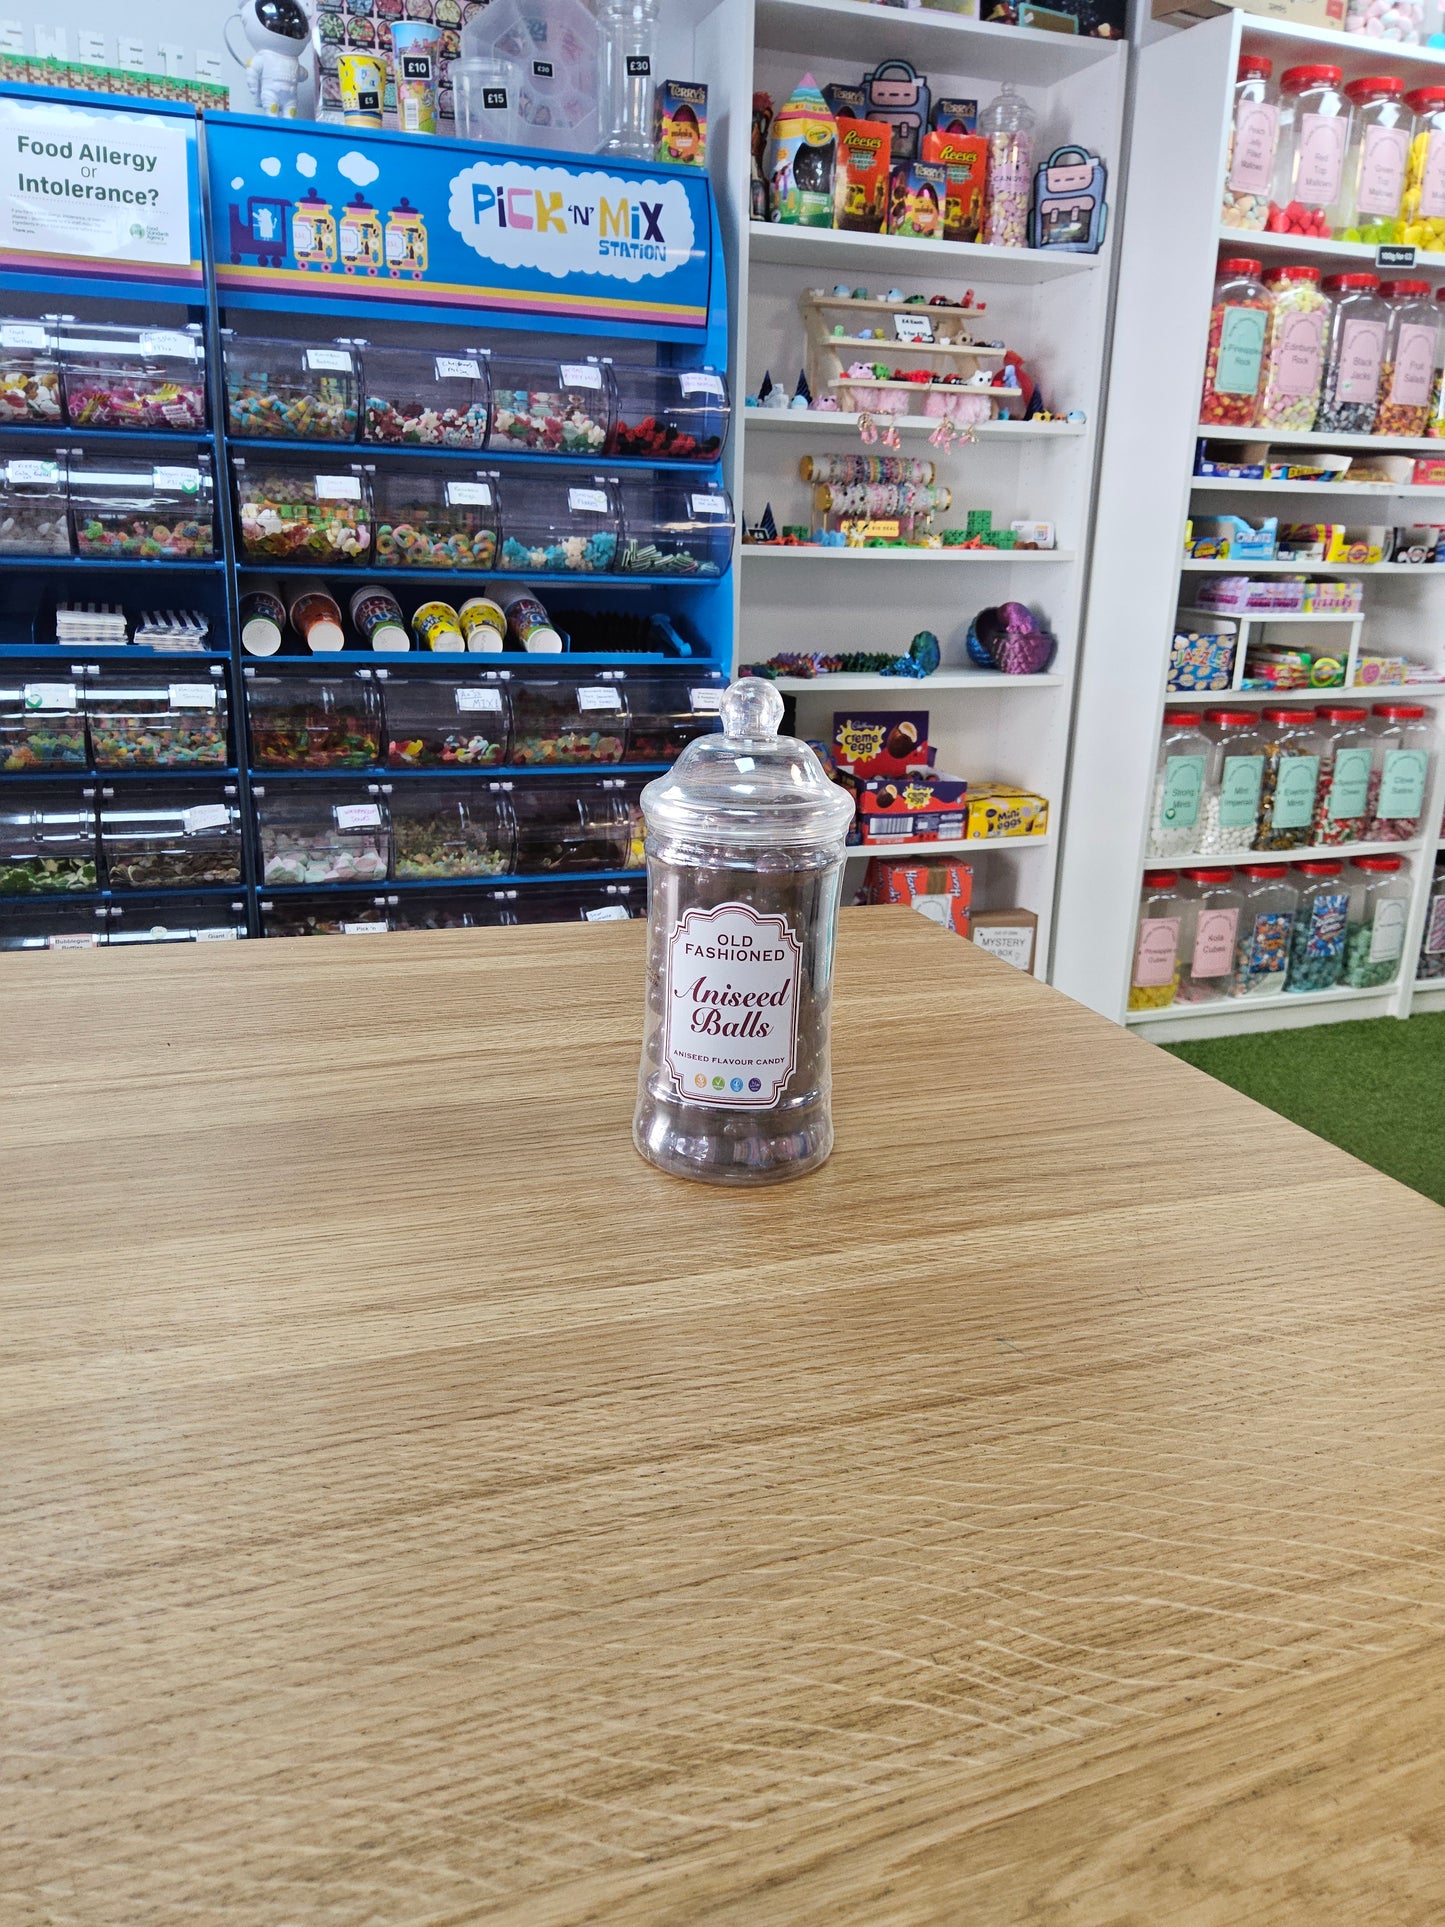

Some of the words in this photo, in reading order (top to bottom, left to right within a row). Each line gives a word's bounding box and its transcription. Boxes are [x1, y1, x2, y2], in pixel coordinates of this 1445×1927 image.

[407, 61, 427, 74] £10
[629, 60, 649, 72] £30
[364, 96, 374, 105] £5
[487, 92, 505, 104] £15
[17, 135, 73, 159] Food
[79, 143, 158, 173] Allergy
[80, 166, 98, 178] or
[18, 173, 160, 207] Intolerance?
[1353, 356, 1373, 367] Black
[1173, 647, 1232, 669] JAZZLES
[850, 743, 873, 754] egg
[1172, 788, 1195, 797] Strong
[997, 807, 1020, 821] Mini
[997, 817, 1022, 830] eggs
[55, 938, 90, 947] Bubblegum
[717, 934, 753, 947] OLD
[981, 937, 1025, 948] MYSTERY
[685, 943, 785, 962] FASHIONED
[1202, 946, 1226, 954] Cubes
[674, 976, 791, 1008] Aniseed
[690, 1007, 774, 1038] Balls
[673, 1049, 710, 1063] ANISEED
[711, 1057, 754, 1066] FLAVOUR
[756, 1057, 786, 1066] CANDY
